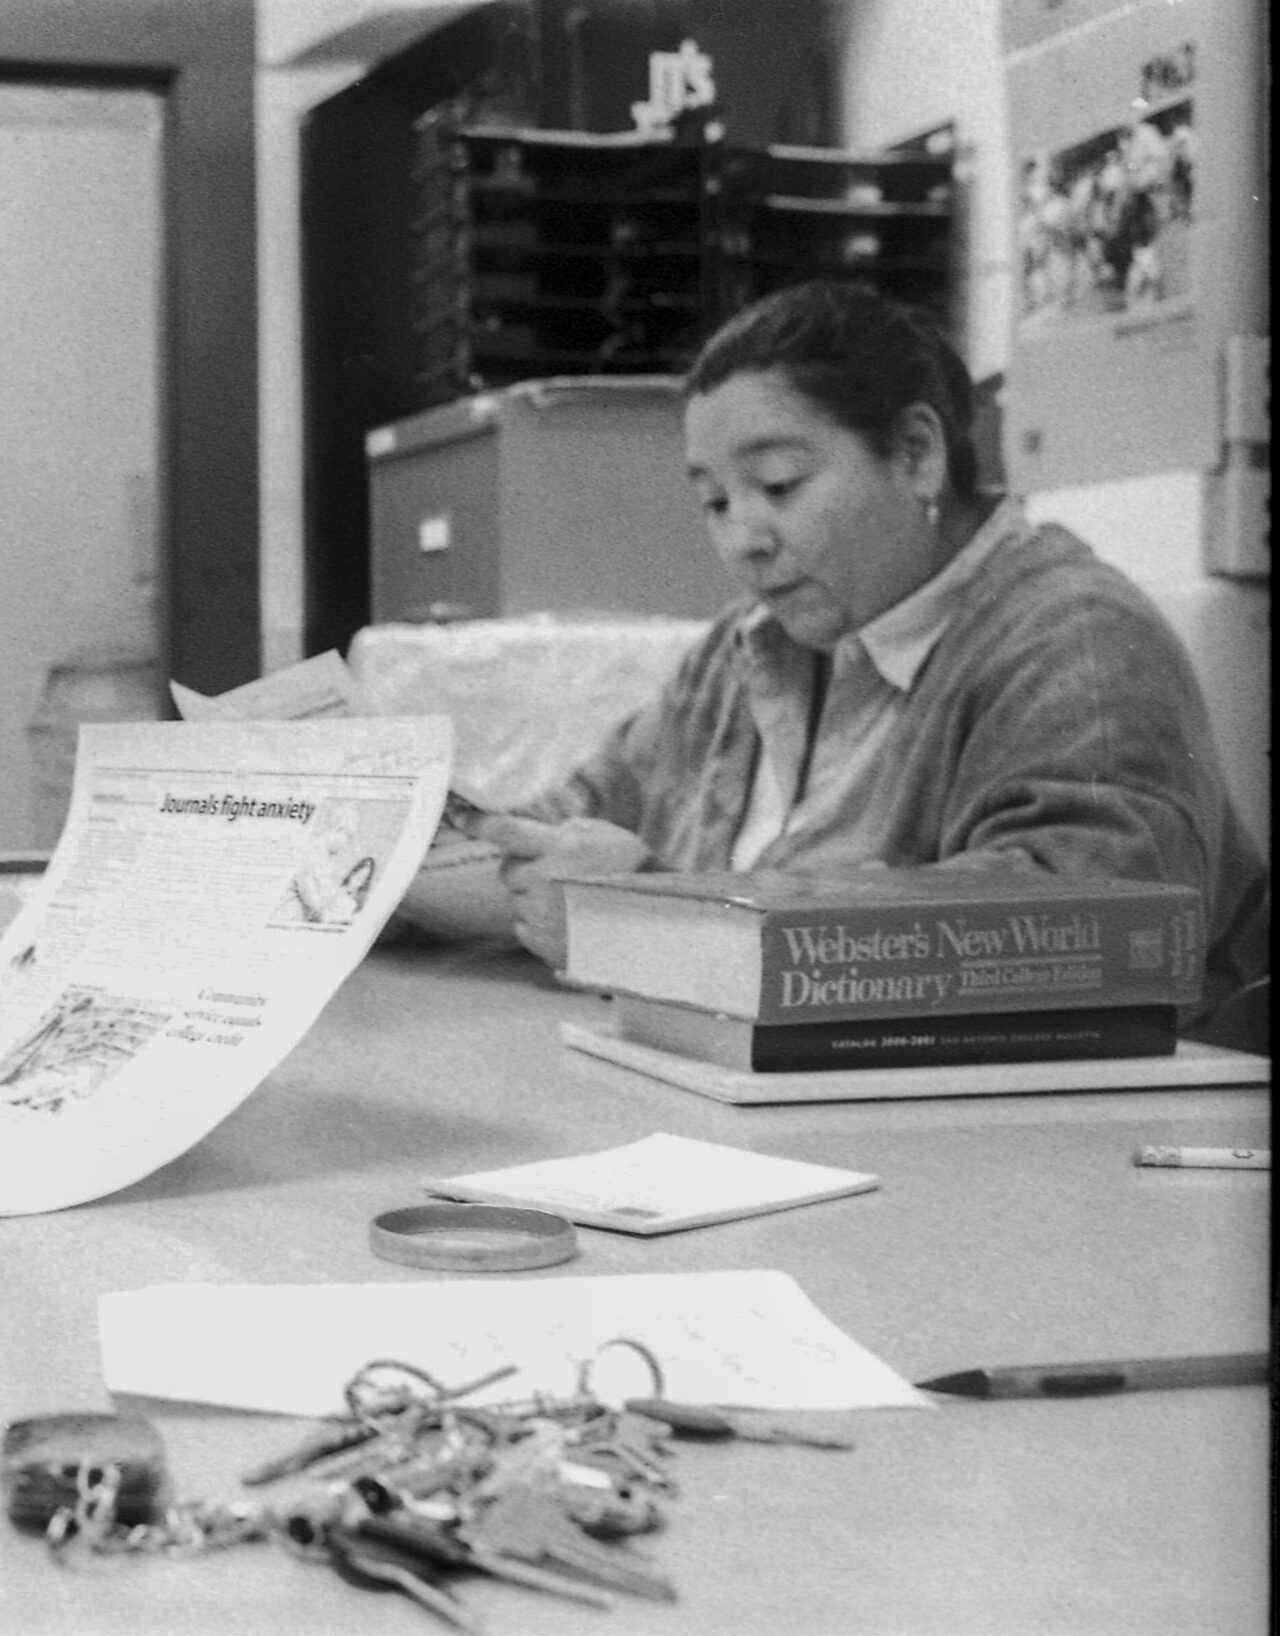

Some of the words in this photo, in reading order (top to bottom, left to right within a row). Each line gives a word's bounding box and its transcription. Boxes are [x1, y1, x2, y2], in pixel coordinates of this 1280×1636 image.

[160, 792, 219, 816] Journals
[221, 794, 256, 822] fight
[257, 797, 317, 825] anxiety
[781, 921, 930, 966] Webster's
[935, 918, 1008, 958] New
[1006, 913, 1102, 954] World
[779, 966, 953, 1008] Dictionary
